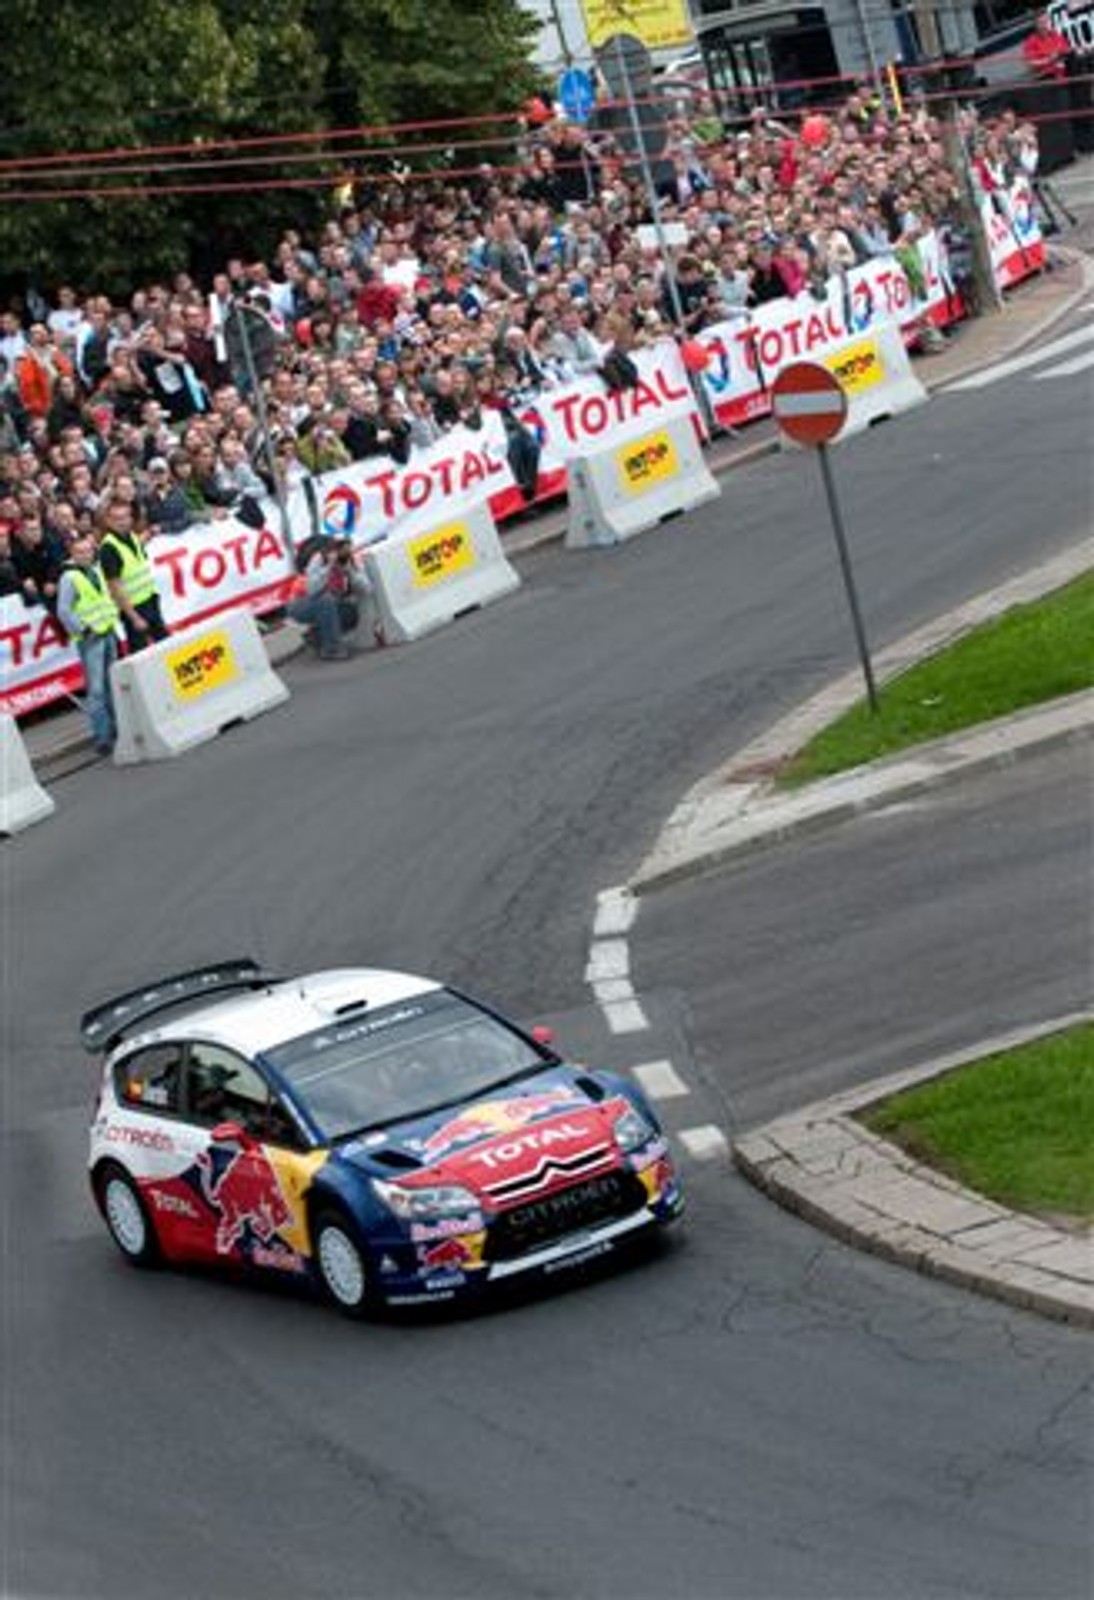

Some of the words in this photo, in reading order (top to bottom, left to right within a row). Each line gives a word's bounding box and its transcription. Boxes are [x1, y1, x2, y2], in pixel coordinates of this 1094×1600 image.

[733, 306, 843, 371] TOTAL
[553, 369, 688, 441] TOTAL
[364, 443, 502, 518] TOTAL
[470, 1123, 589, 1168] TOTAL
